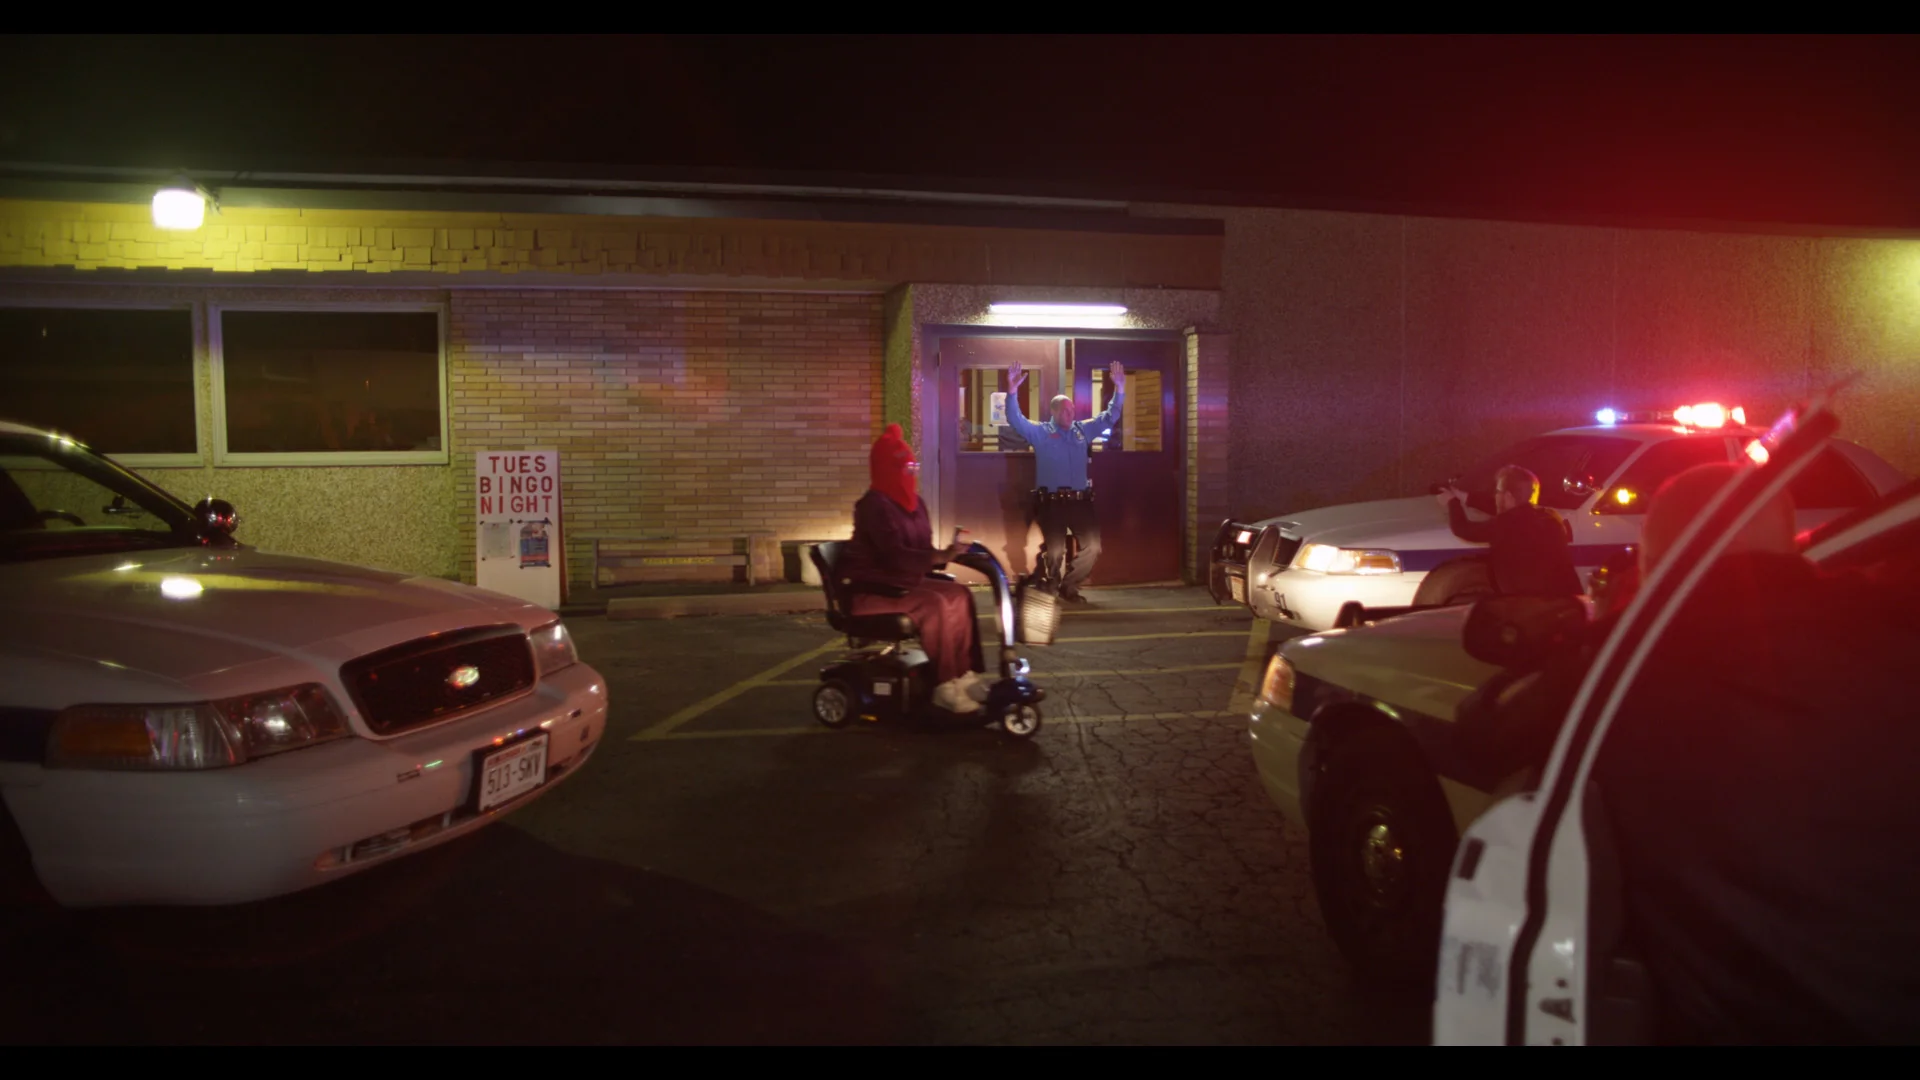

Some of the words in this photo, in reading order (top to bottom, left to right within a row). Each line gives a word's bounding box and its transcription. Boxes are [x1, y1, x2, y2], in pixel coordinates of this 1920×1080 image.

[488, 456, 547, 474] TUES
[480, 476, 553, 494] BINGO
[480, 496, 553, 514] NIGHT
